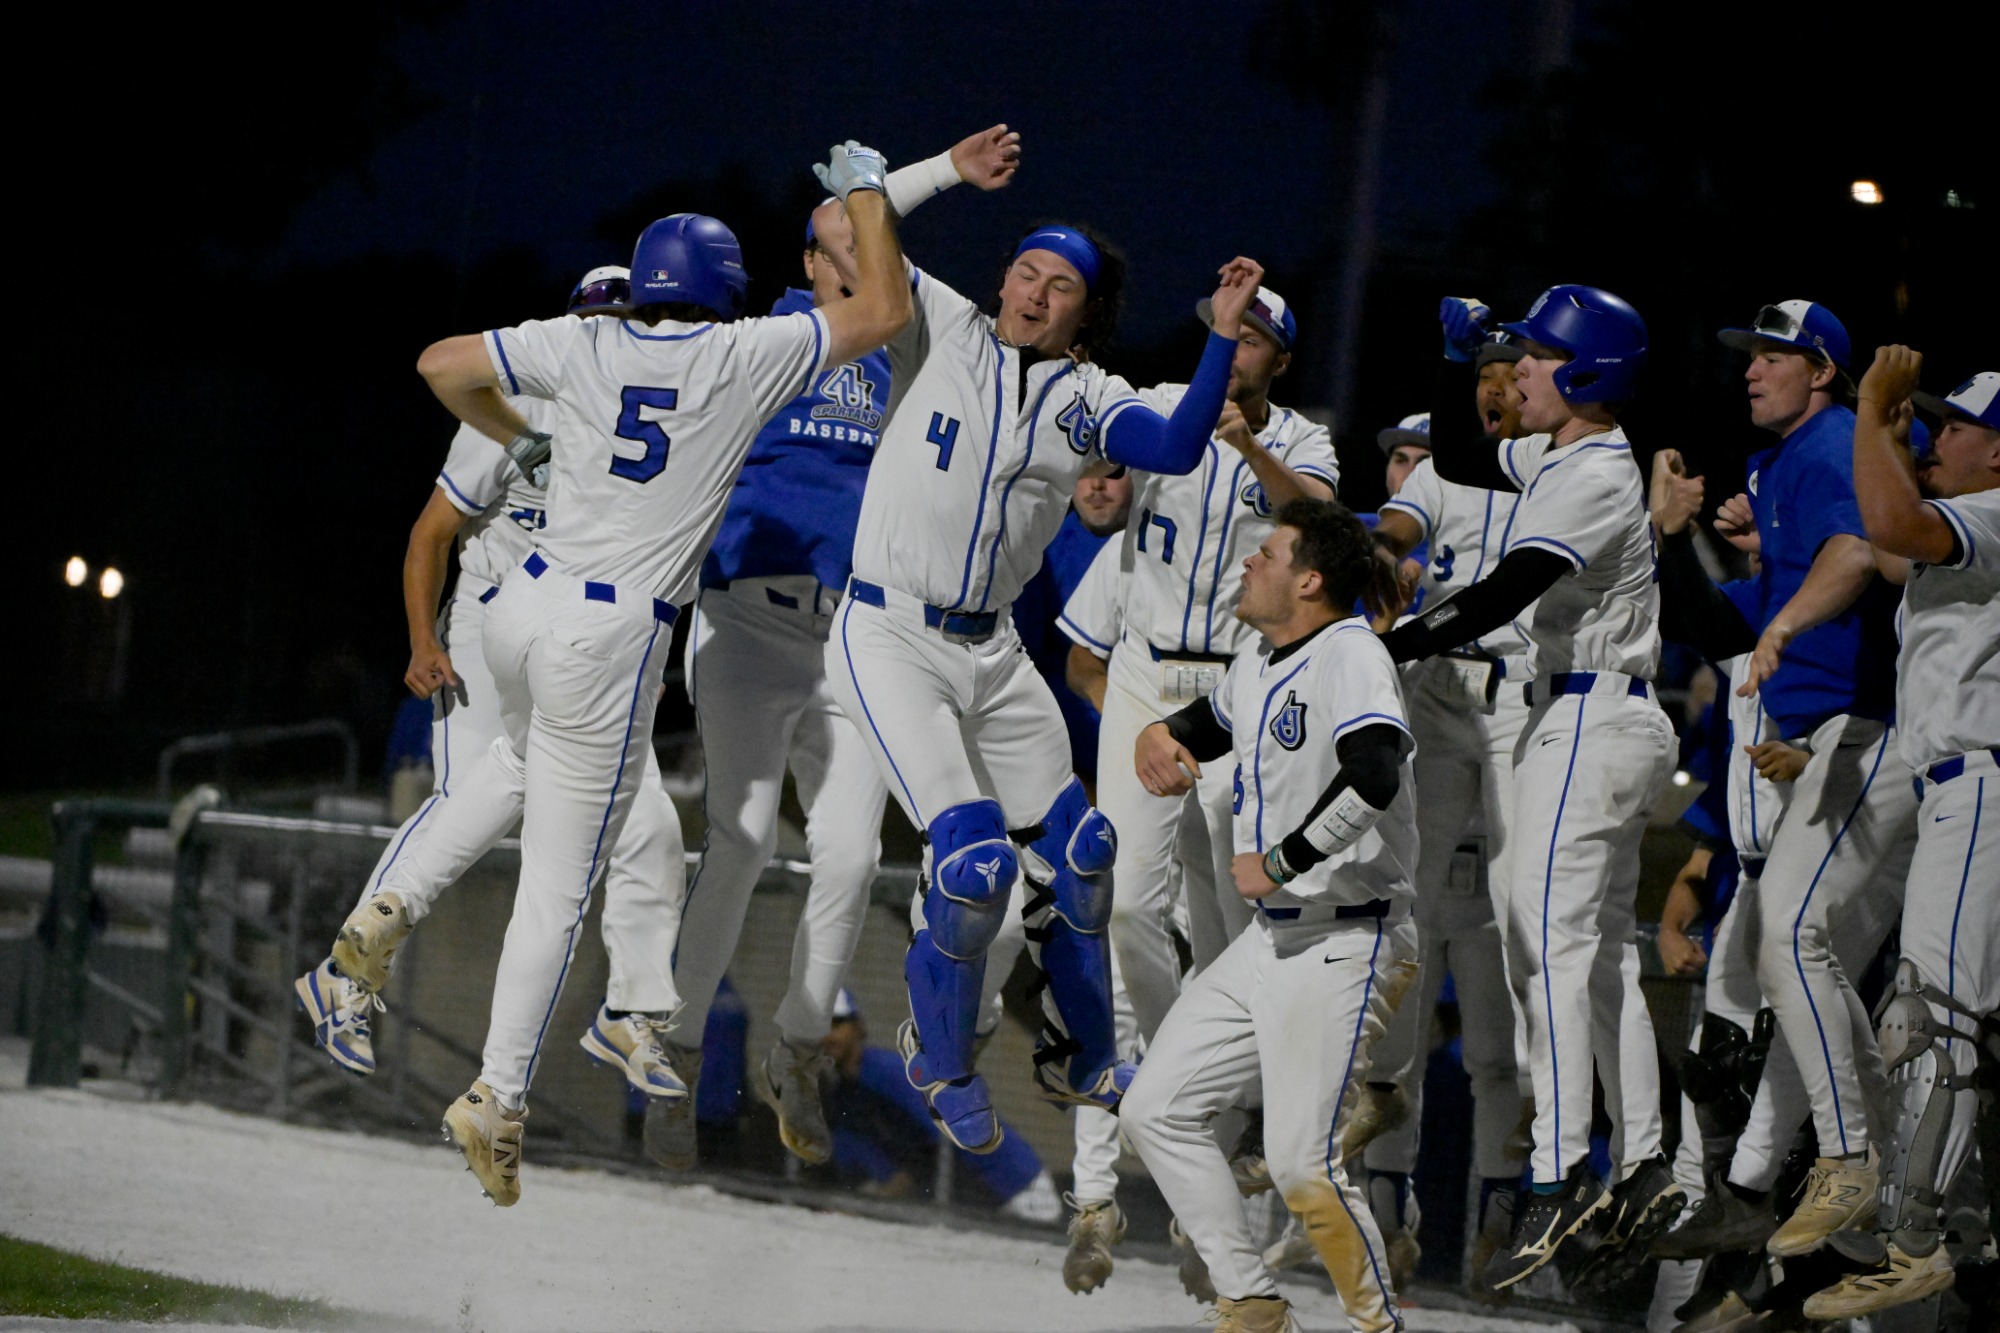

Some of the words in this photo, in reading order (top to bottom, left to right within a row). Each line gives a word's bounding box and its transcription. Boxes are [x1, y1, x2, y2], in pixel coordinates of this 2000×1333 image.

[608, 385, 679, 485] 5
[789, 417, 880, 446] BASEBA
[813, 404, 880, 428] SPARTANS
[925, 411, 961, 472] 4
[1137, 507, 1178, 565] 17
